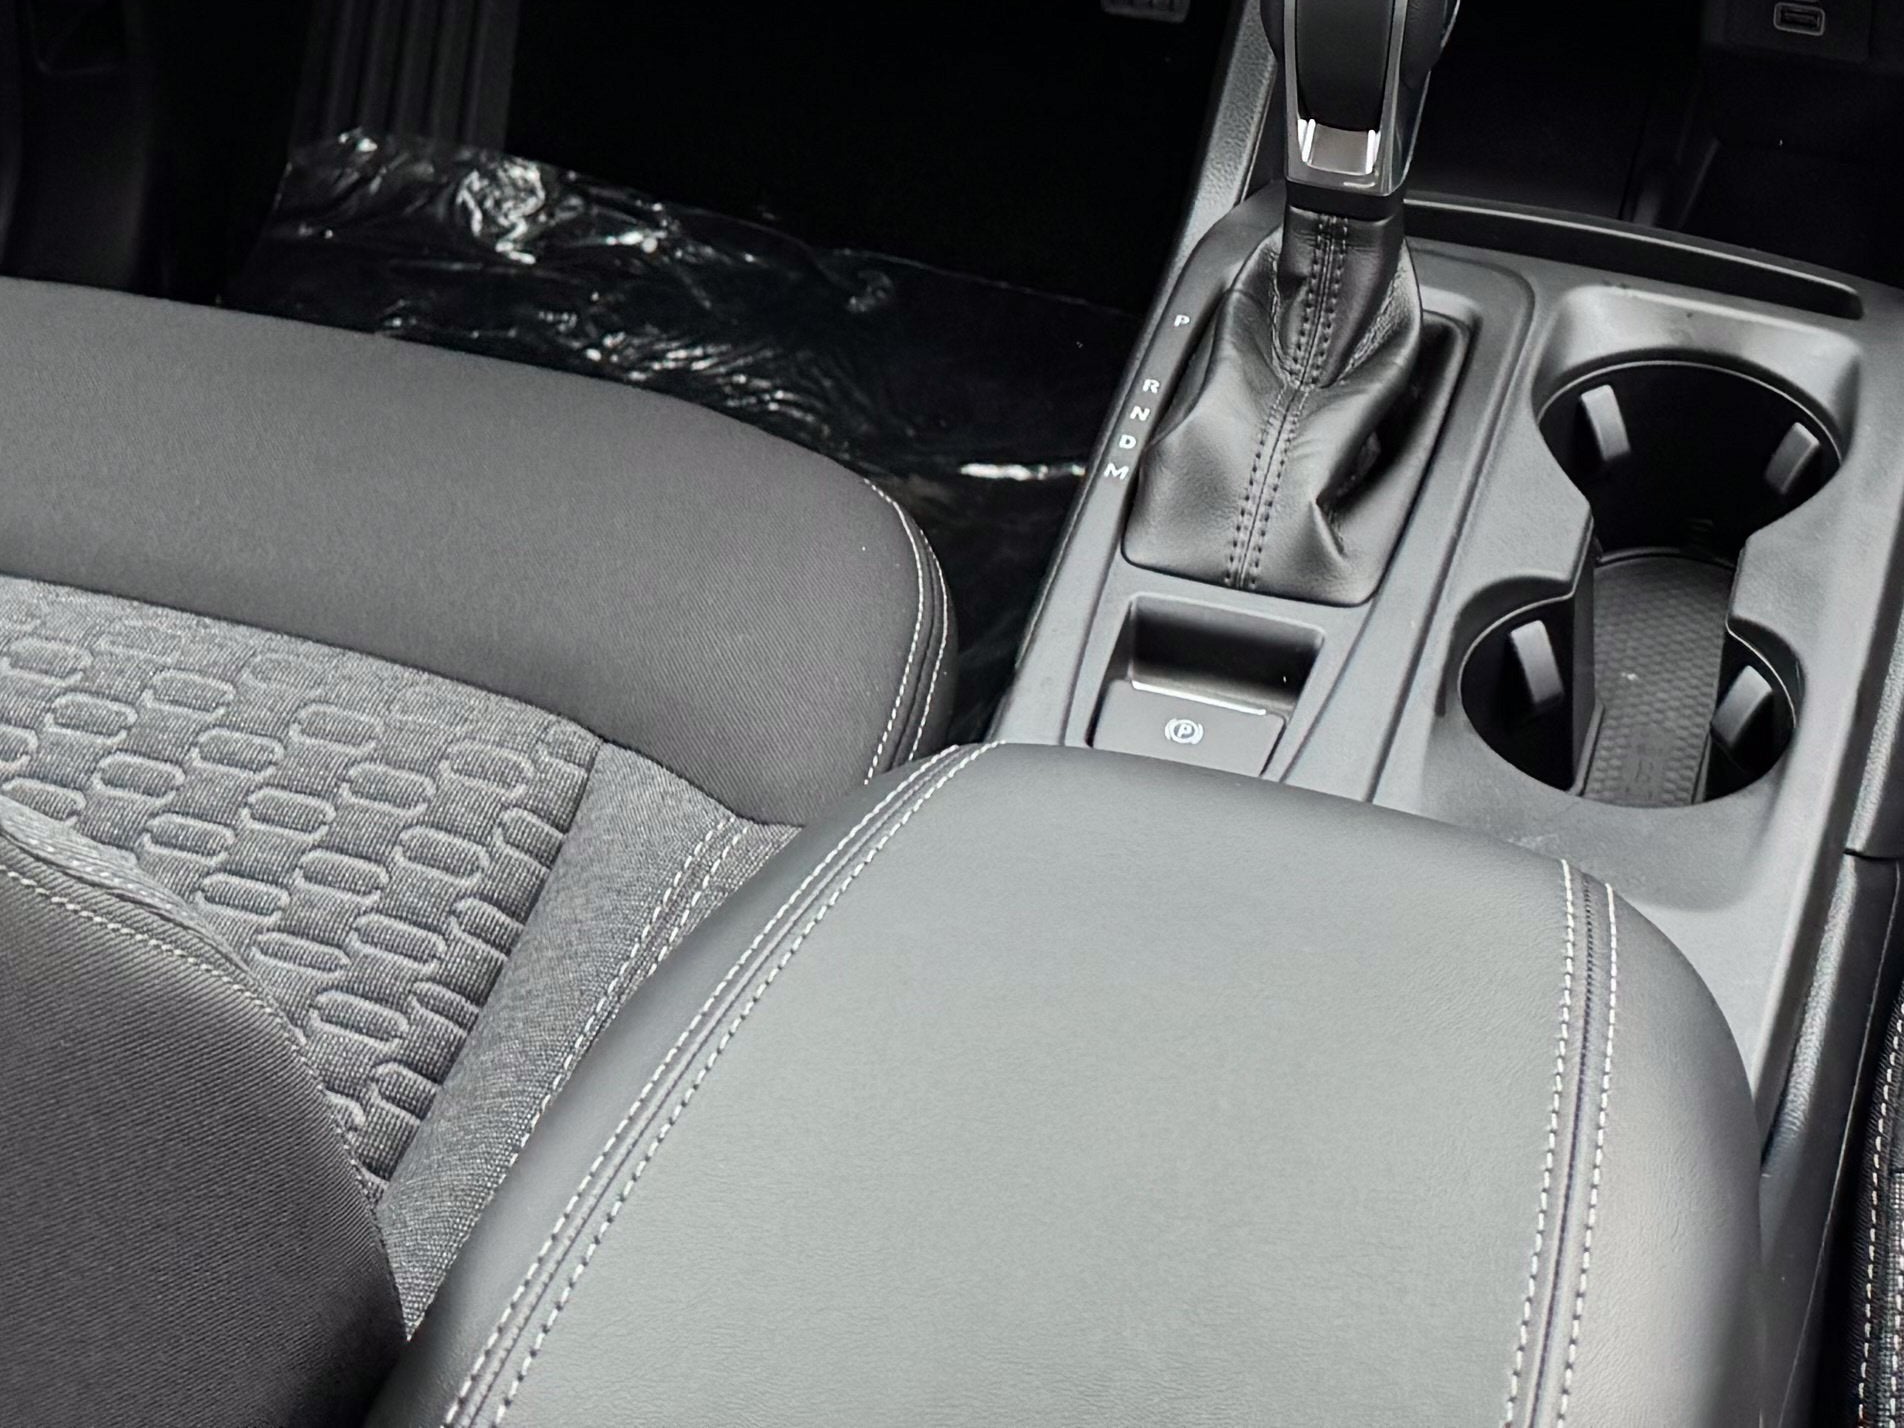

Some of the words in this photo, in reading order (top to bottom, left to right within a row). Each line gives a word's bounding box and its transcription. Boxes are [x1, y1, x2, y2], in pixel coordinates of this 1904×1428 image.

[1174, 314, 1190, 327] P
[1142, 378, 1160, 394] R
[1130, 405, 1151, 421] N
[1119, 434, 1137, 449] D
[1104, 462, 1129, 480] M
